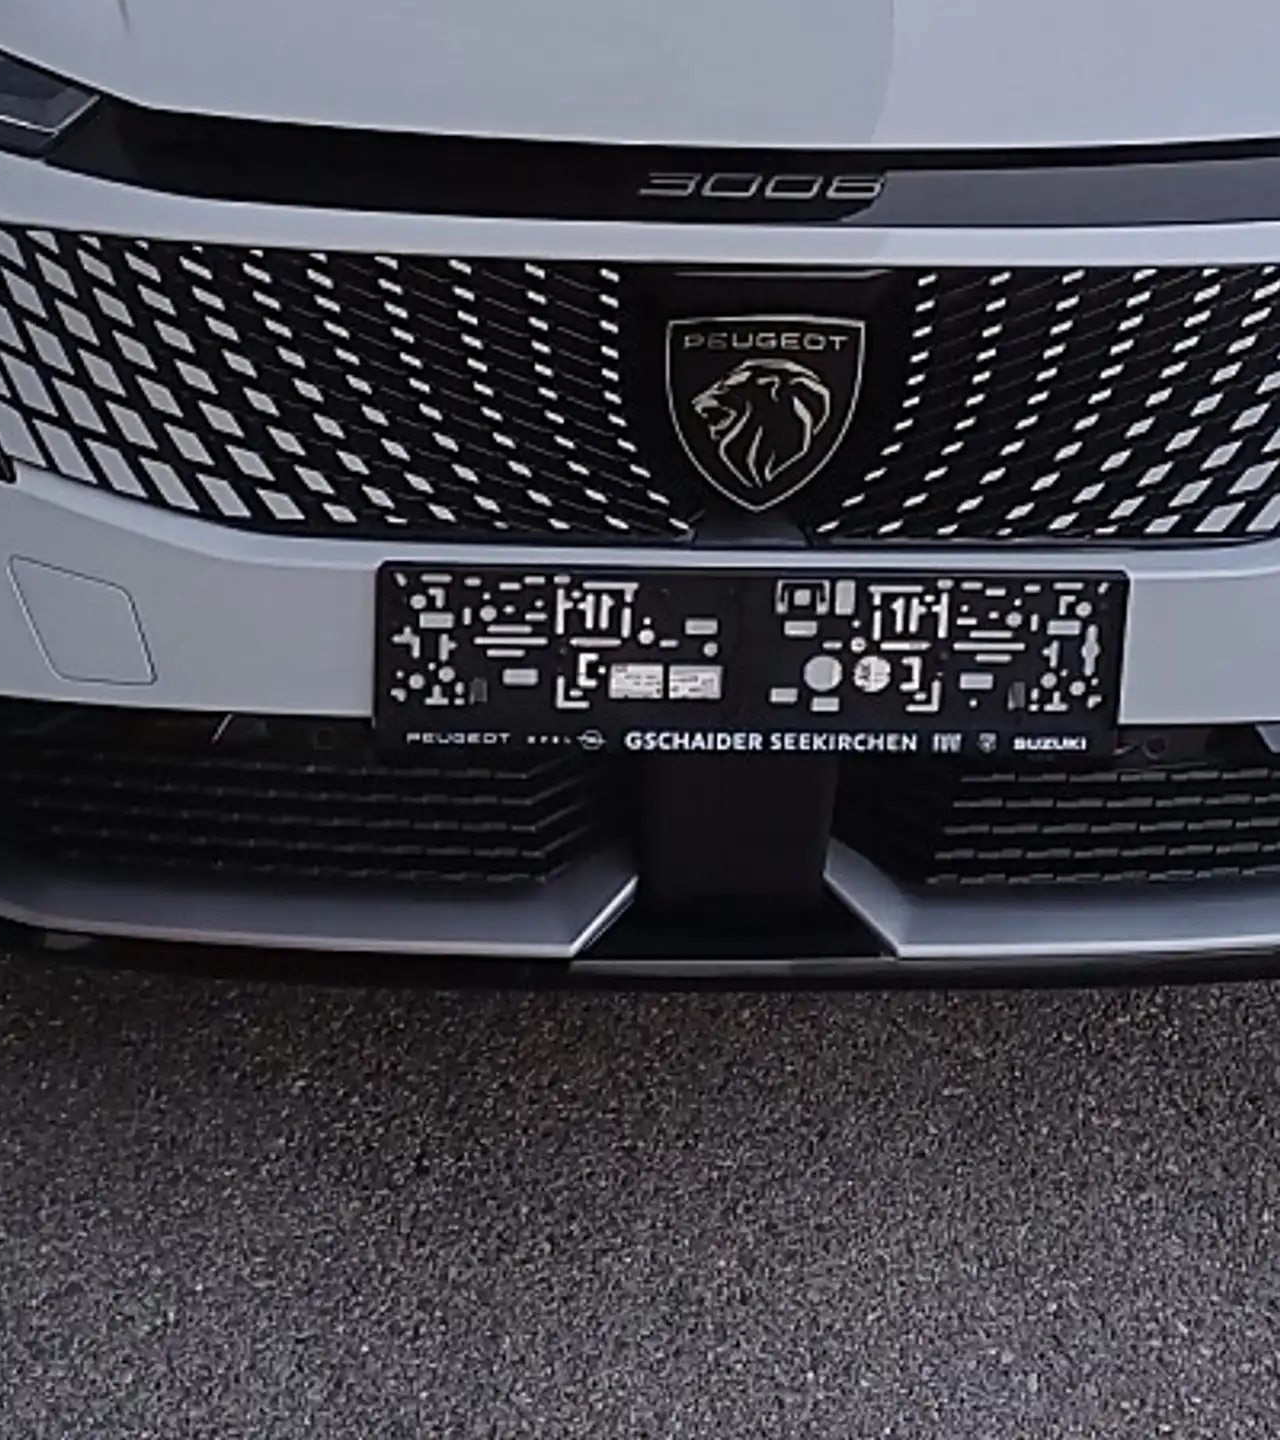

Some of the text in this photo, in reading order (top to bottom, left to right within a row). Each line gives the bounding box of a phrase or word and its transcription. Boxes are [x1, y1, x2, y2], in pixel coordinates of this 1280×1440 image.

[637, 172, 886, 200] 3008
[683, 331, 849, 351] PEUGEOT
[404, 731, 513, 746] PEUGEOT
[624, 730, 766, 753] GSCHAIDER
[771, 730, 919, 753] SEEKIRCHEN
[1012, 735, 1089, 751] SUZUKI
